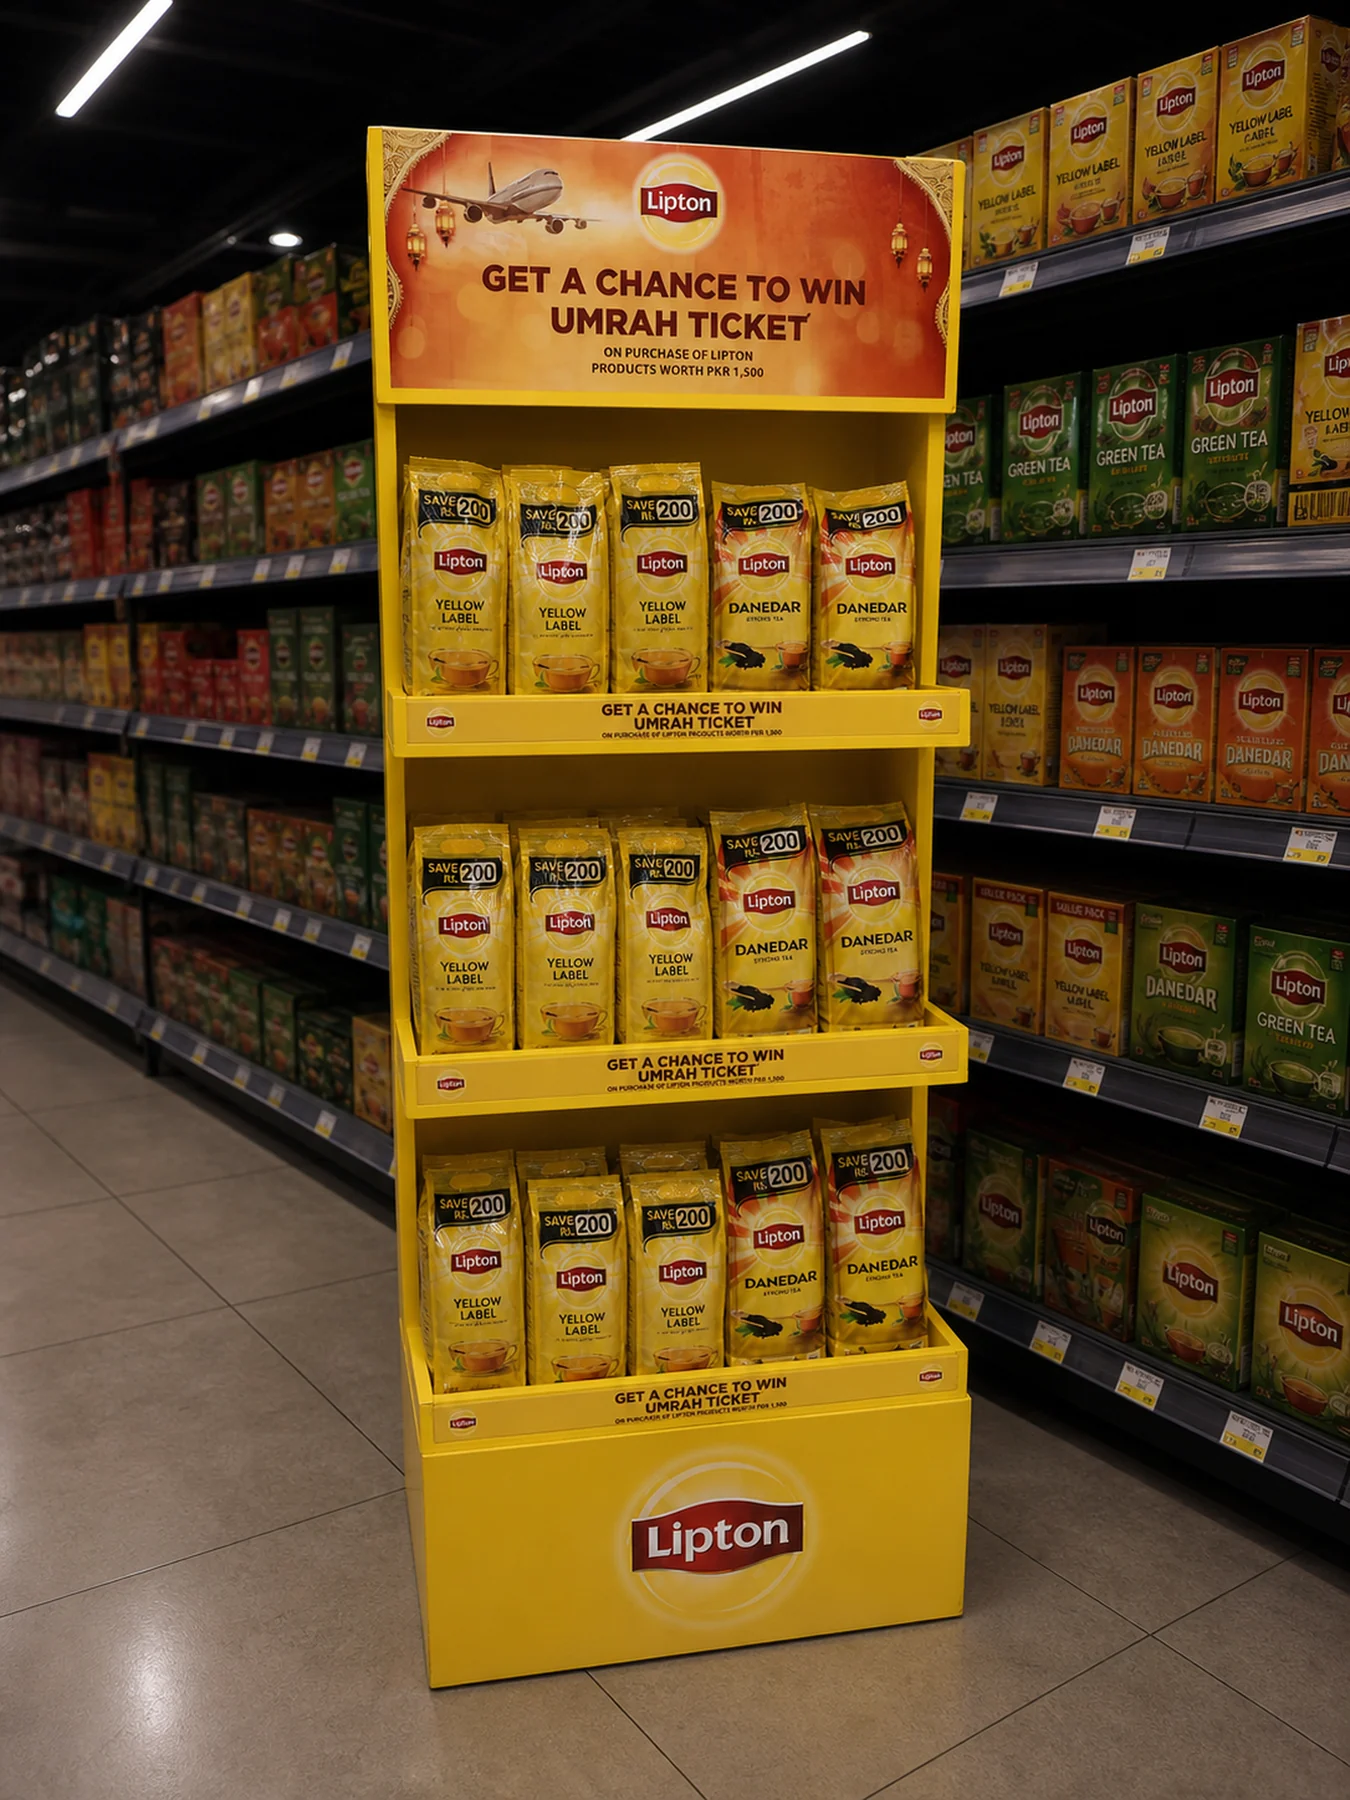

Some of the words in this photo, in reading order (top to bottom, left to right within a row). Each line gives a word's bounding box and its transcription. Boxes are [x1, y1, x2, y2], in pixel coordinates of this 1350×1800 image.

[1246, 66, 1281, 86] Lipton
[1160, 92, 1192, 112] Lipton
[1074, 121, 1104, 140] Lipton
[1092, 158, 1120, 174] LABEL
[647, 191, 711, 214] Lipton
[482, 264, 550, 293] GET
[561, 269, 586, 294] A
[595, 268, 736, 301] CHANCE
[746, 275, 790, 302] TO
[800, 278, 866, 305] WIN
[552, 307, 678, 337] UMRAH
[688, 311, 809, 341] TICKET
[603, 347, 621, 359] ON
[624, 348, 690, 361] PURCHASE
[692, 349, 708, 361] OF
[709, 350, 754, 362] LIPTON
[591, 363, 656, 376] PRODUCTS
[658, 364, 705, 377] WORTH
[706, 365, 731, 377] PKR
[733, 365, 764, 379] 1,500
[1210, 378, 1254, 400] Lipton
[1112, 398, 1153, 418] Lipton
[1023, 414, 1059, 433] Lipton
[1191, 433, 1236, 454] GREEN
[1241, 430, 1268, 448] TEA
[1097, 446, 1137, 467] GREEN
[1141, 443, 1165, 460] TEA
[1008, 459, 1046, 478] GREEN
[1048, 457, 1071, 473] TEA
[460, 499, 488, 520] 200
[627, 500, 654, 510] SAVE
[659, 502, 691, 518] 200
[728, 506, 757, 517] SAVE
[761, 505, 795, 520] 200
[559, 513, 590, 528] 200
[866, 511, 899, 525] 200
[439, 554, 483, 570] Lipton
[641, 558, 683, 572] Lipton
[742, 559, 785, 573] Lipton
[850, 558, 892, 573] Lipton
[541, 565, 584, 580] Lipton
[436, 600, 485, 611] YELLOW
[539, 607, 586, 618] YELLOW
[640, 601, 686, 612] YELLOW
[729, 601, 801, 614] DANEDAR
[837, 602, 907, 615] DANEDAR
[442, 612, 479, 624] LABEL
[546, 620, 581, 631] LABEL
[646, 614, 681, 624] LABEL
[1000, 663, 1029, 674] Lipton
[1080, 687, 1113, 701] Lipton
[1157, 689, 1192, 704] Lipton
[1243, 693, 1281, 708] Lipton
[602, 704, 633, 716] GET
[638, 703, 649, 715] A
[654, 703, 720, 715] CHANCE
[724, 702, 745, 714] TO
[750, 702, 782, 714] WIN
[634, 717, 693, 730] UMRAH
[698, 716, 755, 729] TICKET
[1142, 737, 1203, 762] DANEDAR
[1225, 746, 1293, 772] DANEDAR
[727, 838, 759, 850] SAVE
[763, 833, 798, 851] 200
[828, 830, 860, 843] SAVE
[864, 827, 898, 845] 200
[428, 863, 458, 873] SAVE
[462, 864, 495, 880] 200
[535, 862, 563, 873] SAVE
[567, 862, 598, 879] 200
[634, 858, 662, 869] SAVE
[666, 861, 692, 876] 200
[852, 885, 896, 901] Lipton
[748, 894, 791, 910] Lipton
[444, 918, 486, 932] Lipton
[550, 915, 591, 930] Lipton
[650, 912, 688, 926] Lipton
[842, 930, 912, 948] DANEDAR
[991, 926, 1021, 942] Lipton
[736, 938, 808, 956] DANEDAR
[1068, 942, 1100, 961] Lipton
[547, 958, 594, 969] YELLOW
[649, 954, 693, 965] YELLOW
[1162, 947, 1203, 967] Lipton
[441, 961, 489, 972] YELLOW
[655, 966, 689, 976] LABEL
[447, 974, 483, 984] LABEL
[553, 970, 588, 981] LABEL
[1146, 976, 1218, 1012] DANEDAR
[1276, 975, 1321, 999] Lipton
[1257, 1012, 1304, 1036] GREEN
[1308, 1023, 1336, 1044] TEA
[607, 1058, 638, 1071] GET
[642, 1057, 654, 1069] A
[658, 1053, 723, 1067] CHANCE
[727, 1051, 748, 1064] TO
[753, 1049, 784, 1062] WIN
[638, 1068, 696, 1082] UMRAH
[701, 1064, 757, 1078] TICKET
[838, 1154, 868, 1168] SAVE
[872, 1152, 906, 1171] 200
[736, 1169, 767, 1183] SAVE
[770, 1165, 804, 1186] 200
[440, 1199, 468, 1210] SAVE
[471, 1197, 503, 1215] 200
[982, 1196, 1020, 1222] Lipton
[544, 1215, 574, 1226] SAVE
[578, 1215, 609, 1233] 200
[647, 1210, 674, 1222] SAVE
[678, 1208, 708, 1227] 200
[859, 1214, 901, 1233] Lipton
[758, 1229, 800, 1247] Lipton
[1090, 1218, 1125, 1242] Lipton
[456, 1254, 498, 1270] Lipton
[847, 1256, 918, 1275] DANEDAR
[561, 1271, 603, 1287] Lipton
[664, 1264, 703, 1280] Lipton
[745, 1271, 817, 1289] DANEDAR
[1166, 1263, 1214, 1296] Lipton
[454, 1296, 501, 1309] YELLOW
[461, 1308, 496, 1320] LABEL
[559, 1313, 605, 1324] YELLOW
[661, 1305, 705, 1317] YELLOW
[566, 1325, 600, 1336] LABEL
[668, 1317, 700, 1328] LABEL
[1284, 1305, 1338, 1343] Lipton
[615, 1391, 645, 1404] GET
[649, 1390, 660, 1401] A
[664, 1383, 728, 1399] CHANCE
[732, 1380, 752, 1392] TO
[756, 1377, 787, 1390] WIN
[646, 1398, 702, 1414] UMRAH
[706, 1392, 760, 1407] TICKET
[648, 1518, 789, 1562] Lipton
